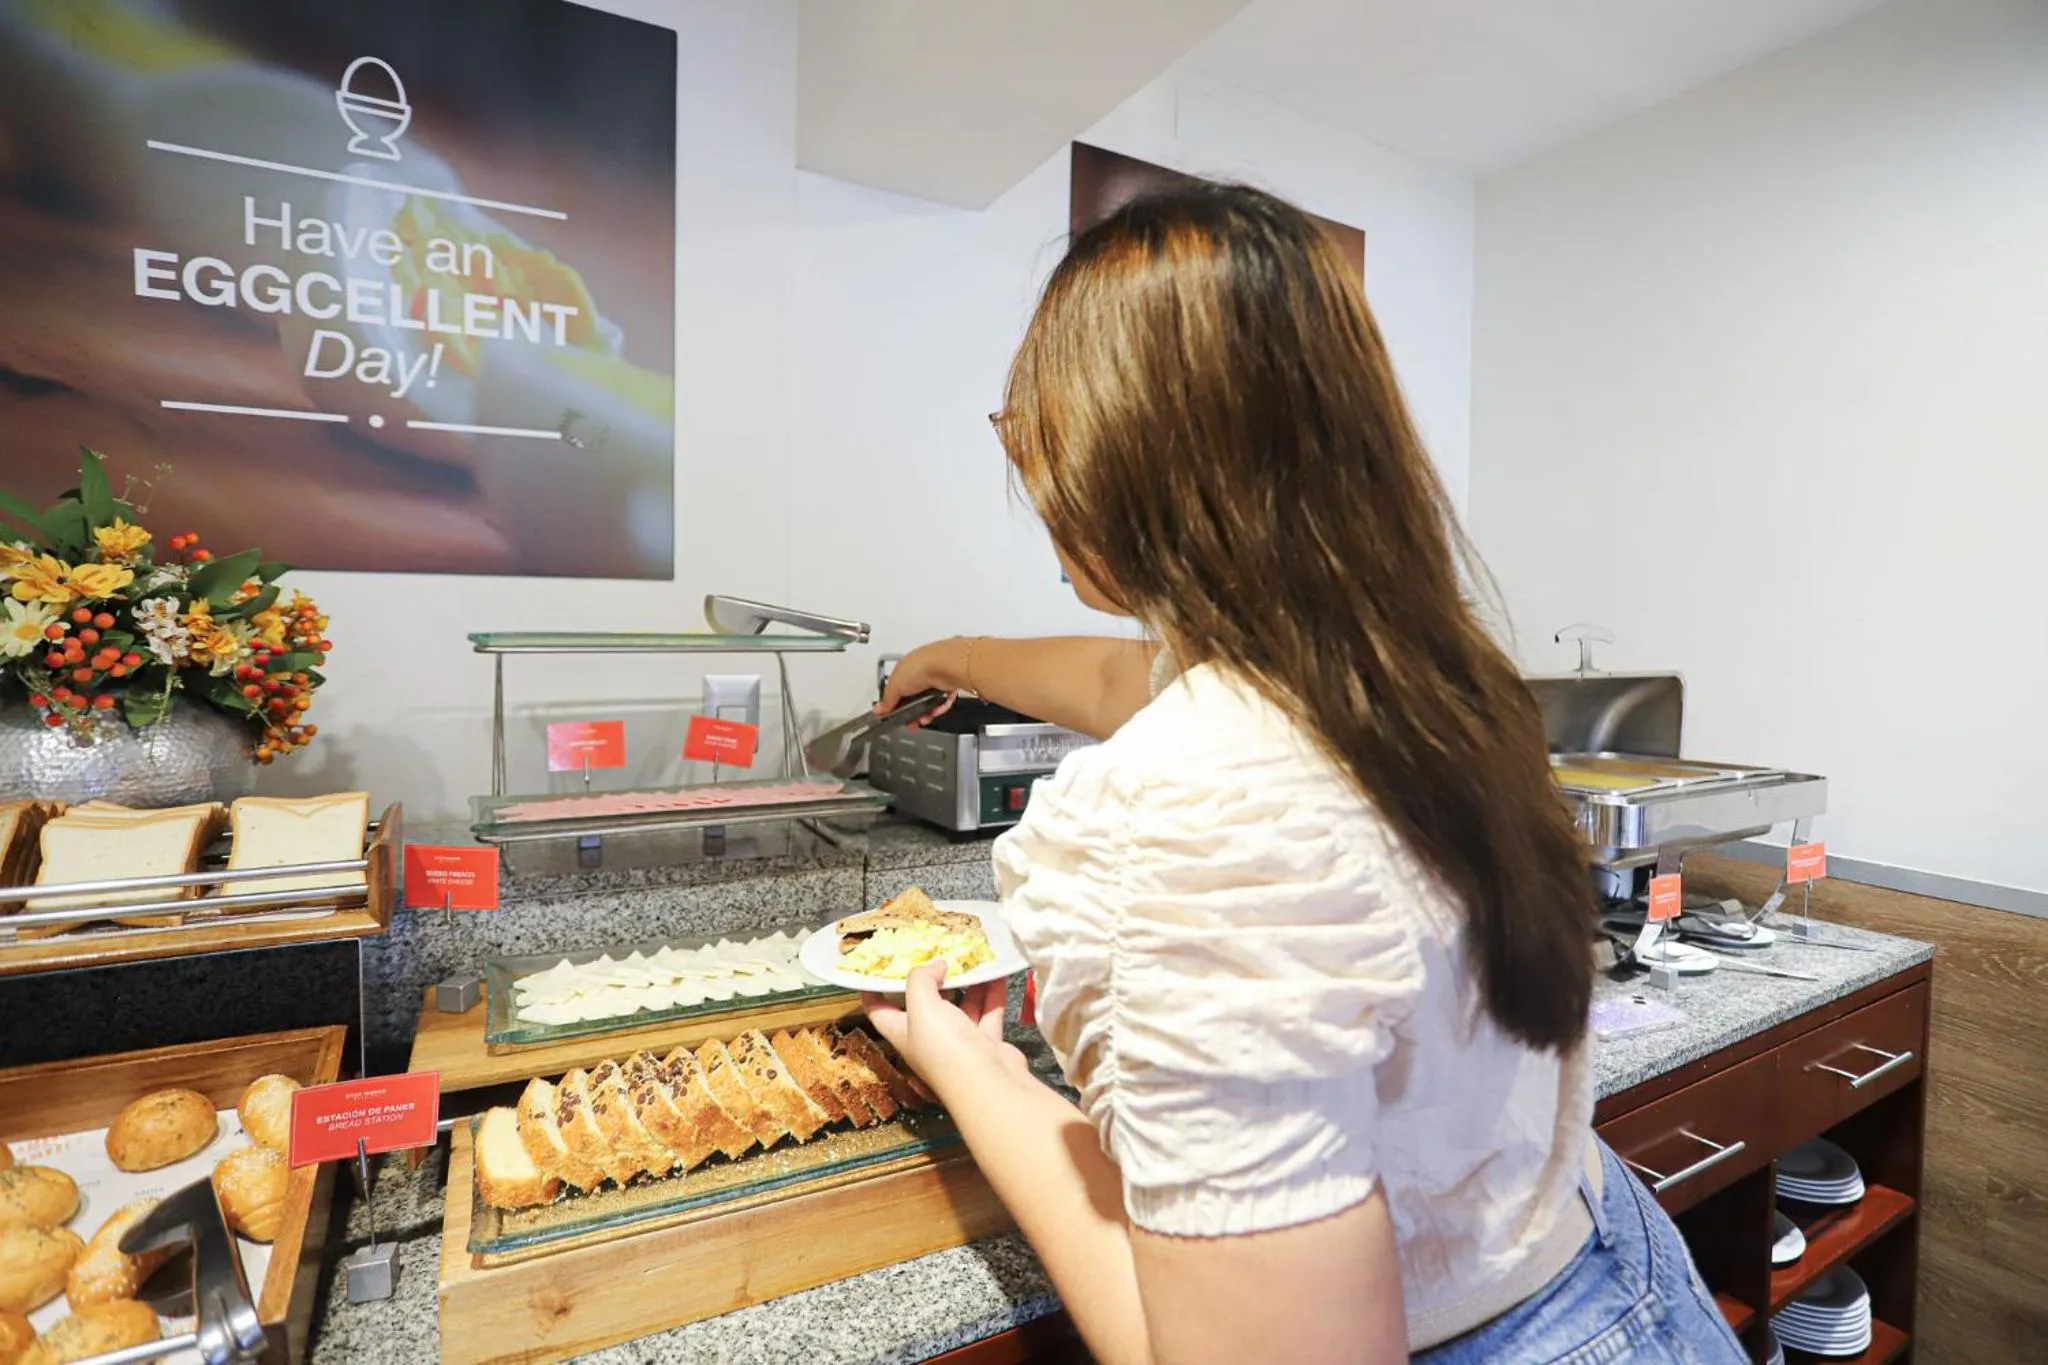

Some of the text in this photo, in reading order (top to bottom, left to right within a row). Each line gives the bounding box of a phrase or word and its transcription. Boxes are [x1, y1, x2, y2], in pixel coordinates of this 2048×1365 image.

[244, 196, 494, 278] Have an
[133, 247, 579, 347] EGGCELLENT
[303, 328, 444, 398] Day!
[364, 1113, 404, 1126] STATION
[368, 1106, 382, 1116] DE
